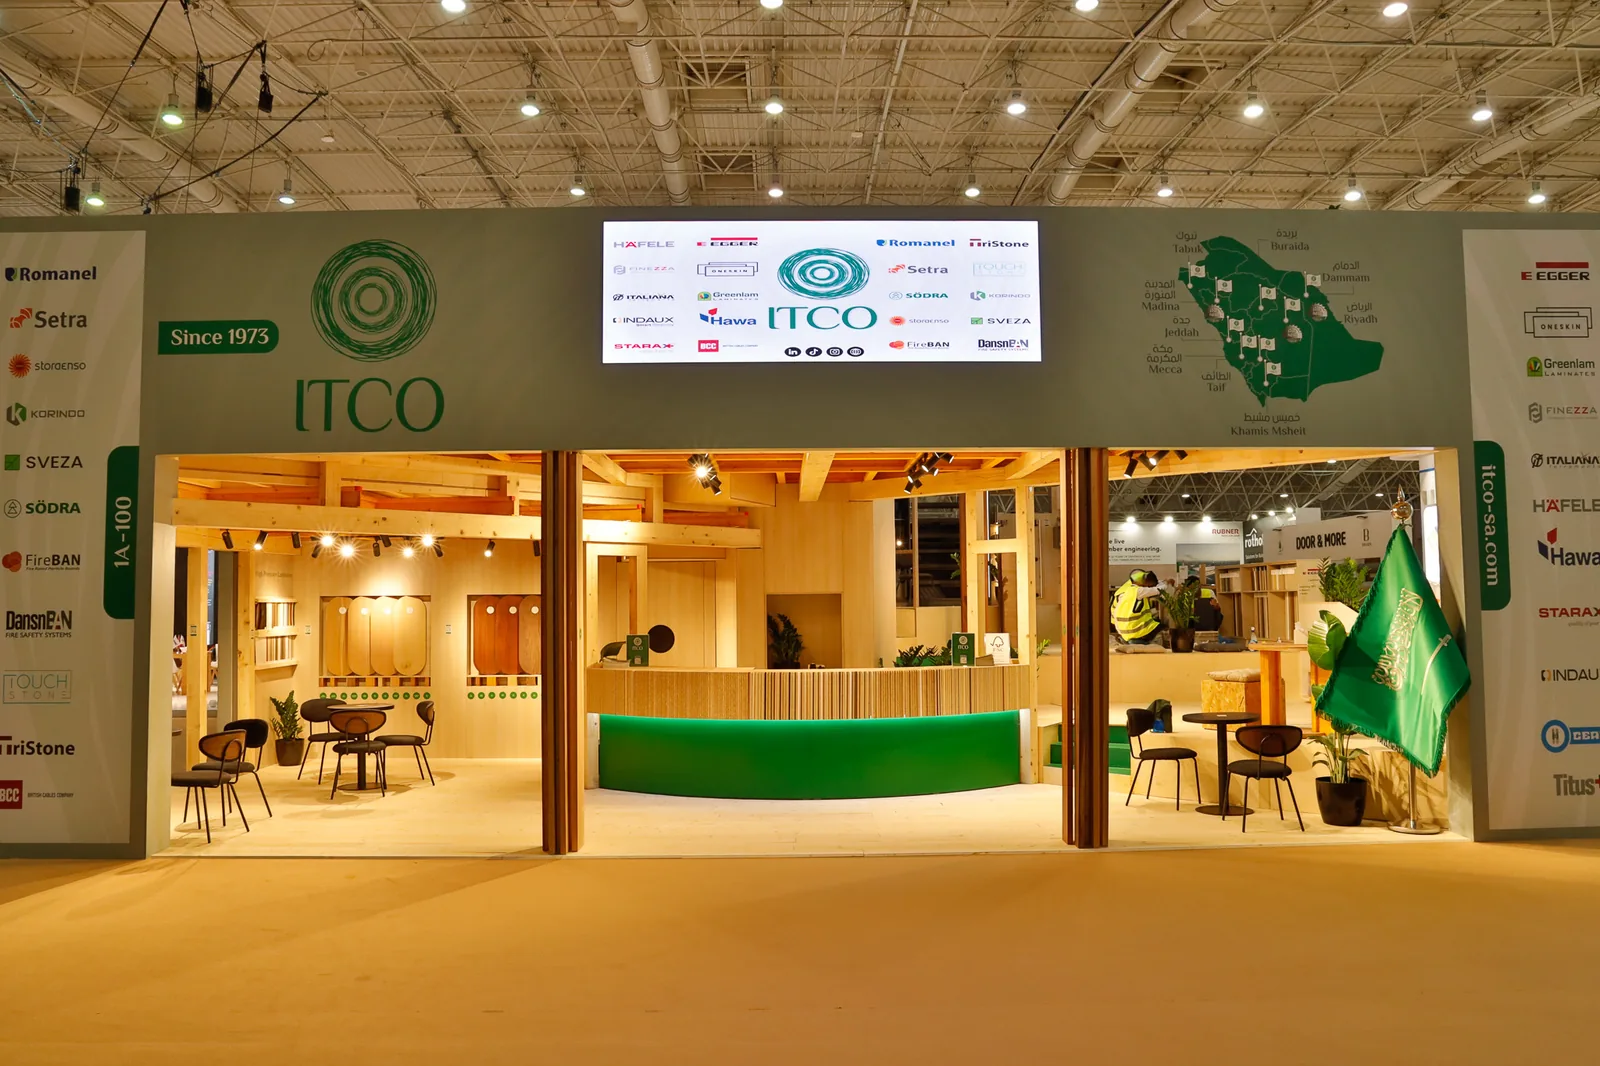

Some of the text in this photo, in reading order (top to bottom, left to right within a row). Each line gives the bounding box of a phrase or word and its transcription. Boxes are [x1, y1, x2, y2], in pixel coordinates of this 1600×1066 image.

[889, 239, 955, 247] Romanel
[969, 239, 1029, 247] TriStone
[1271, 242, 1309, 251] Buraida
[1173, 245, 1203, 253] Tabuk
[908, 265, 948, 274] Setra
[1333, 262, 1359, 271] الدمام
[20, 266, 96, 281] Romanel
[1323, 273, 1370, 282] Dammam
[1537, 272, 1590, 280] EGGER
[1145, 280, 1175, 289] المدينة
[1142, 302, 1180, 311] Madina
[1347, 303, 1372, 312] الرياض
[34, 311, 87, 328] Setra
[711, 317, 757, 325] Hawa
[768, 306, 877, 330] ITCO
[1173, 317, 1190, 326] جدة
[1344, 315, 1378, 325] Riyadh
[171, 328, 269, 345] Since 1973
[1165, 328, 1199, 337] Jeddah
[978, 339, 1029, 347] DansnBAN
[1153, 345, 1173, 353] مكة
[1147, 354, 1182, 363] المكرمة
[35, 361, 86, 371] storaenso
[1544, 359, 1595, 369] Greenlam
[1149, 365, 1182, 374] Mecca
[1202, 372, 1231, 381] الطائف
[1208, 383, 1226, 391] Taif
[296, 377, 445, 432] ITCO
[31, 409, 85, 418] KORINDO
[1244, 413, 1300, 422] خميس مشيط
[1231, 427, 1306, 436] Khamis Msheit
[26, 456, 83, 469] SVEZA
[1547, 456, 1600, 465] ITALIANA
[26, 500, 81, 514] SÖDRA
[1533, 499, 1600, 512] HÄFELE
[1481, 464, 1499, 586] itco-sa.com
[114, 496, 132, 568] 1A-100
[1245, 533, 1263, 548] rotho
[1296, 535, 1315, 550] DOOR
[1317, 534, 1323, 547] &
[1325, 531, 1346, 547] MORE
[26, 554, 81, 566] FireBAN
[1551, 548, 1600, 566] Hawa
[1539, 607, 1600, 618] STARAX
[6, 610, 72, 630] DansnBAN
[8, 674, 68, 689] TOUCH
[0, 788, 19, 802] BCC
